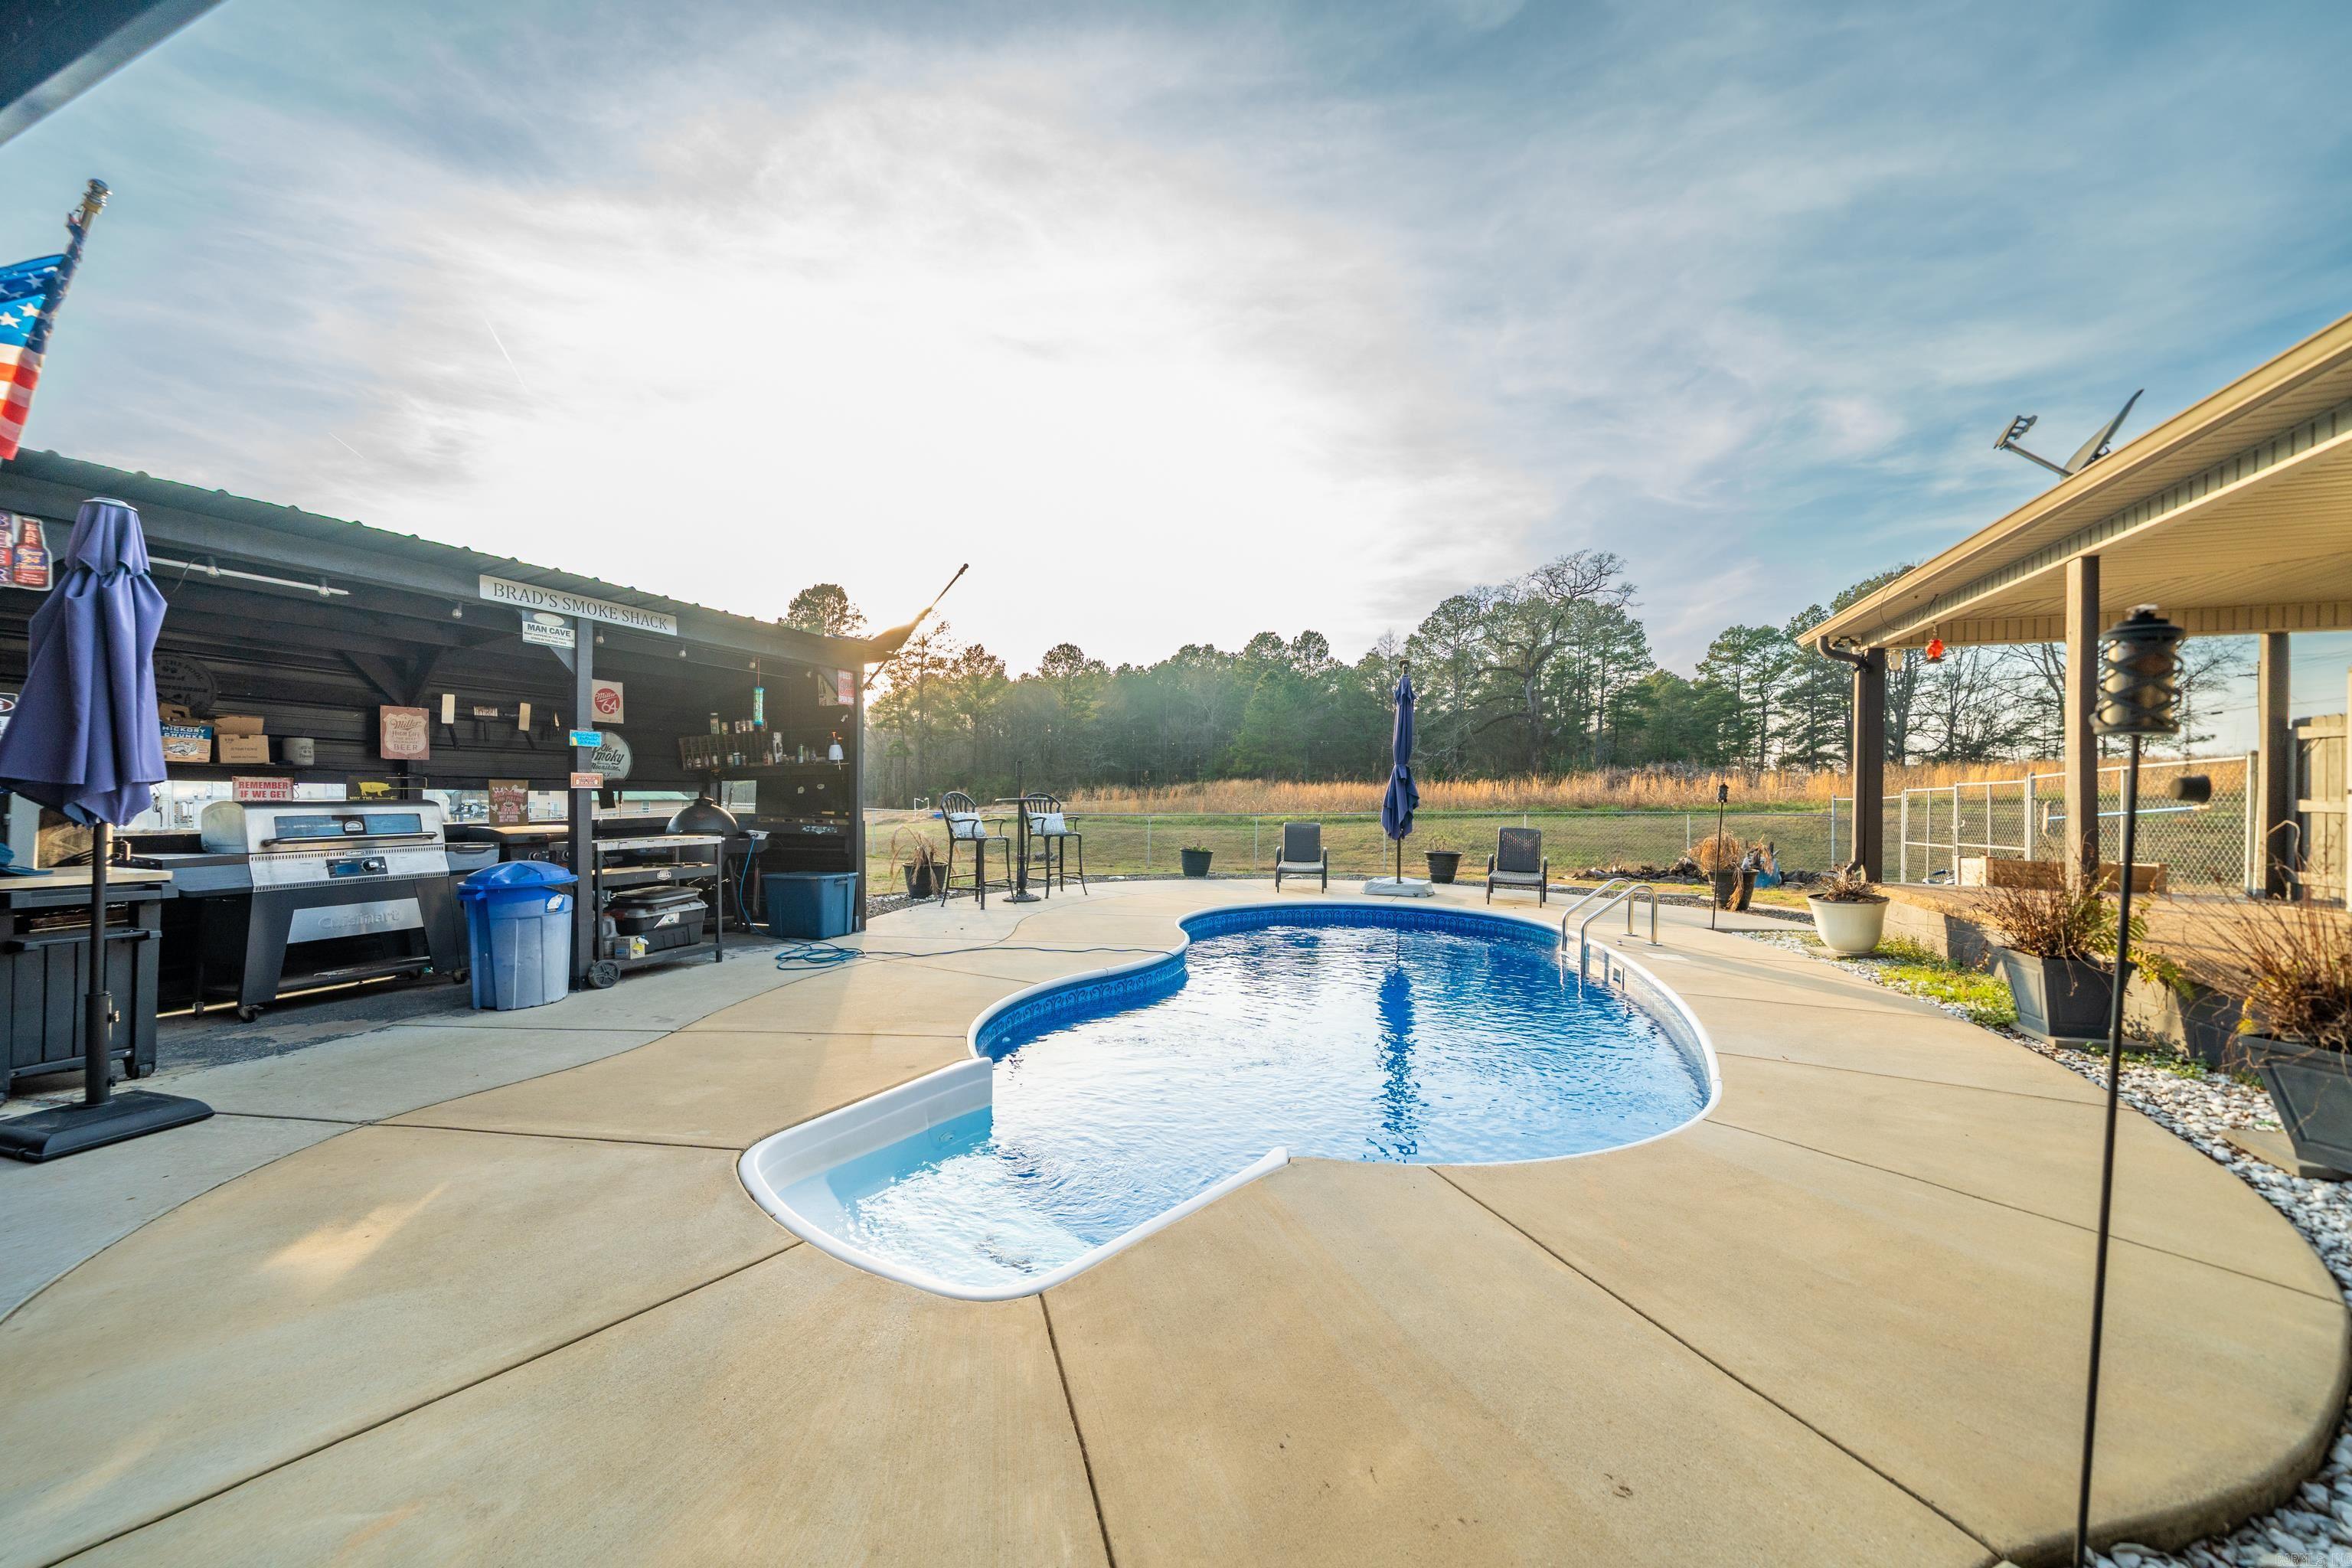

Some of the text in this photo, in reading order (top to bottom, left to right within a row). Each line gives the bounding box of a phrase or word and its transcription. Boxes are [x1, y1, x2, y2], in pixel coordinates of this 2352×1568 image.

[493, 582, 558, 608] BRAD'S
[563, 597, 618, 620] SMOKE
[622, 609, 668, 630] SHACK
[528, 623, 571, 637] MAN CAVE
[596, 692, 616, 701] Miller
[601, 698, 618, 714] 64
[391, 718, 422, 730] Miller
[238, 781, 288, 789] REMEMBER
[270, 790, 286, 799] GET
[318, 910, 400, 929] Cuisinart
